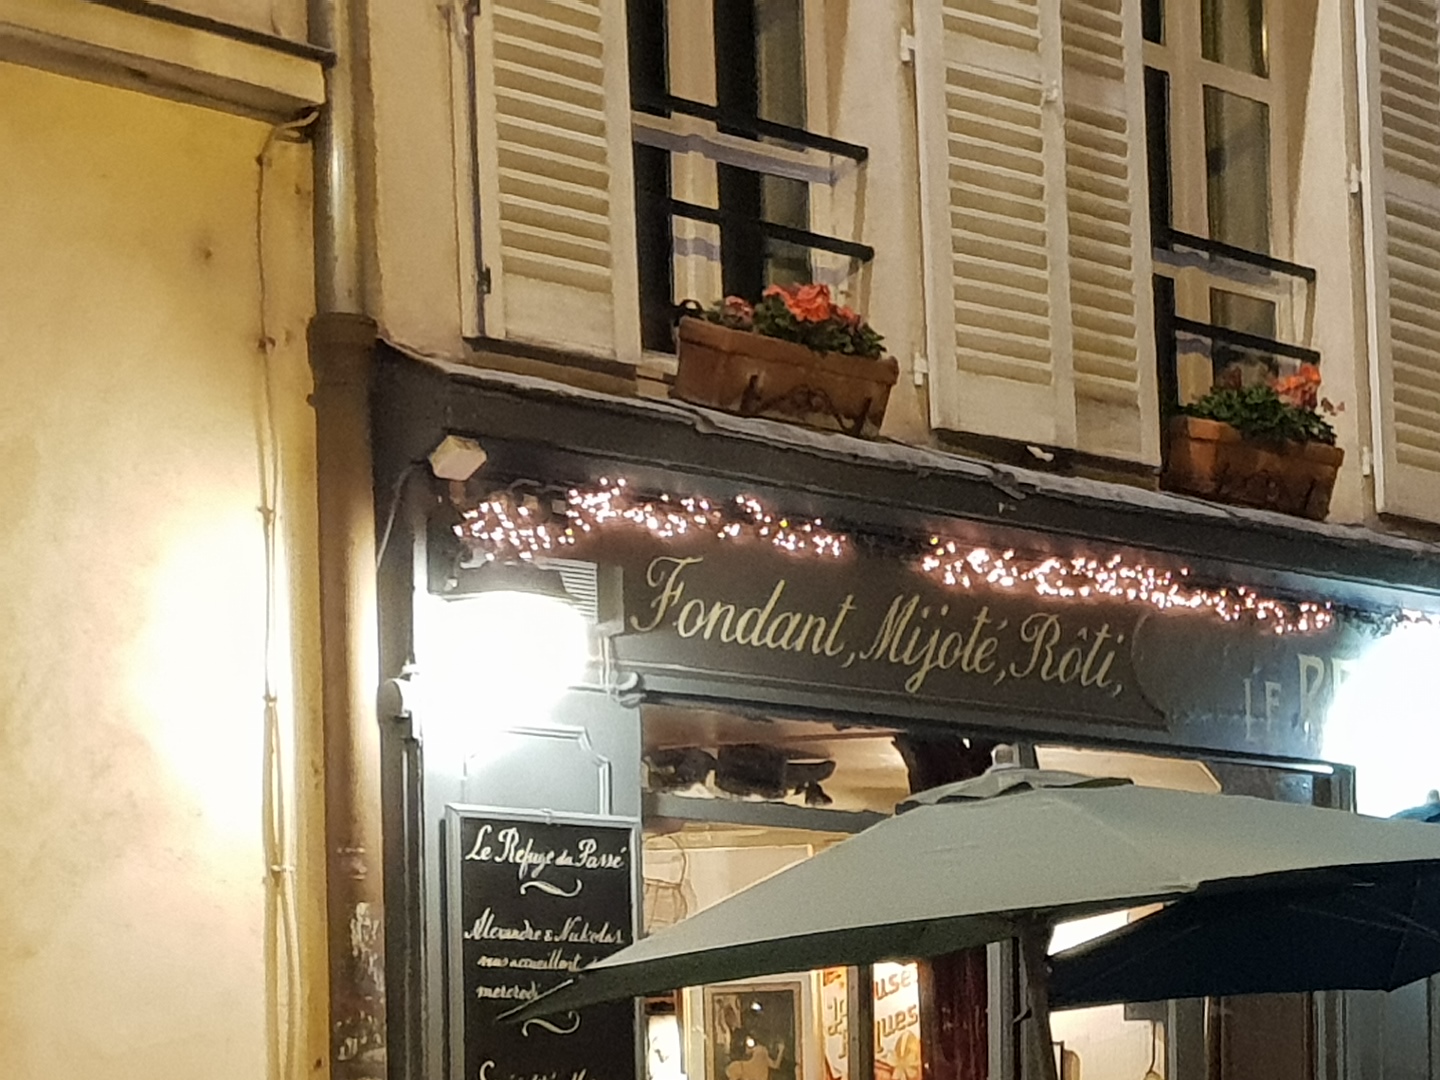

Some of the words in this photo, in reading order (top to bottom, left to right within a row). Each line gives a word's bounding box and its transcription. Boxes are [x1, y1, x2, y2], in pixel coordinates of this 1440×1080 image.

[630, 556, 856, 669] Fondant,
[858, 594, 1007, 694] Mijoté,
[1009, 611, 1124, 698] Rôti,
[465, 824, 492, 861] Le
[494, 827, 555, 880] Refuge
[575, 838, 627, 869] Passé
